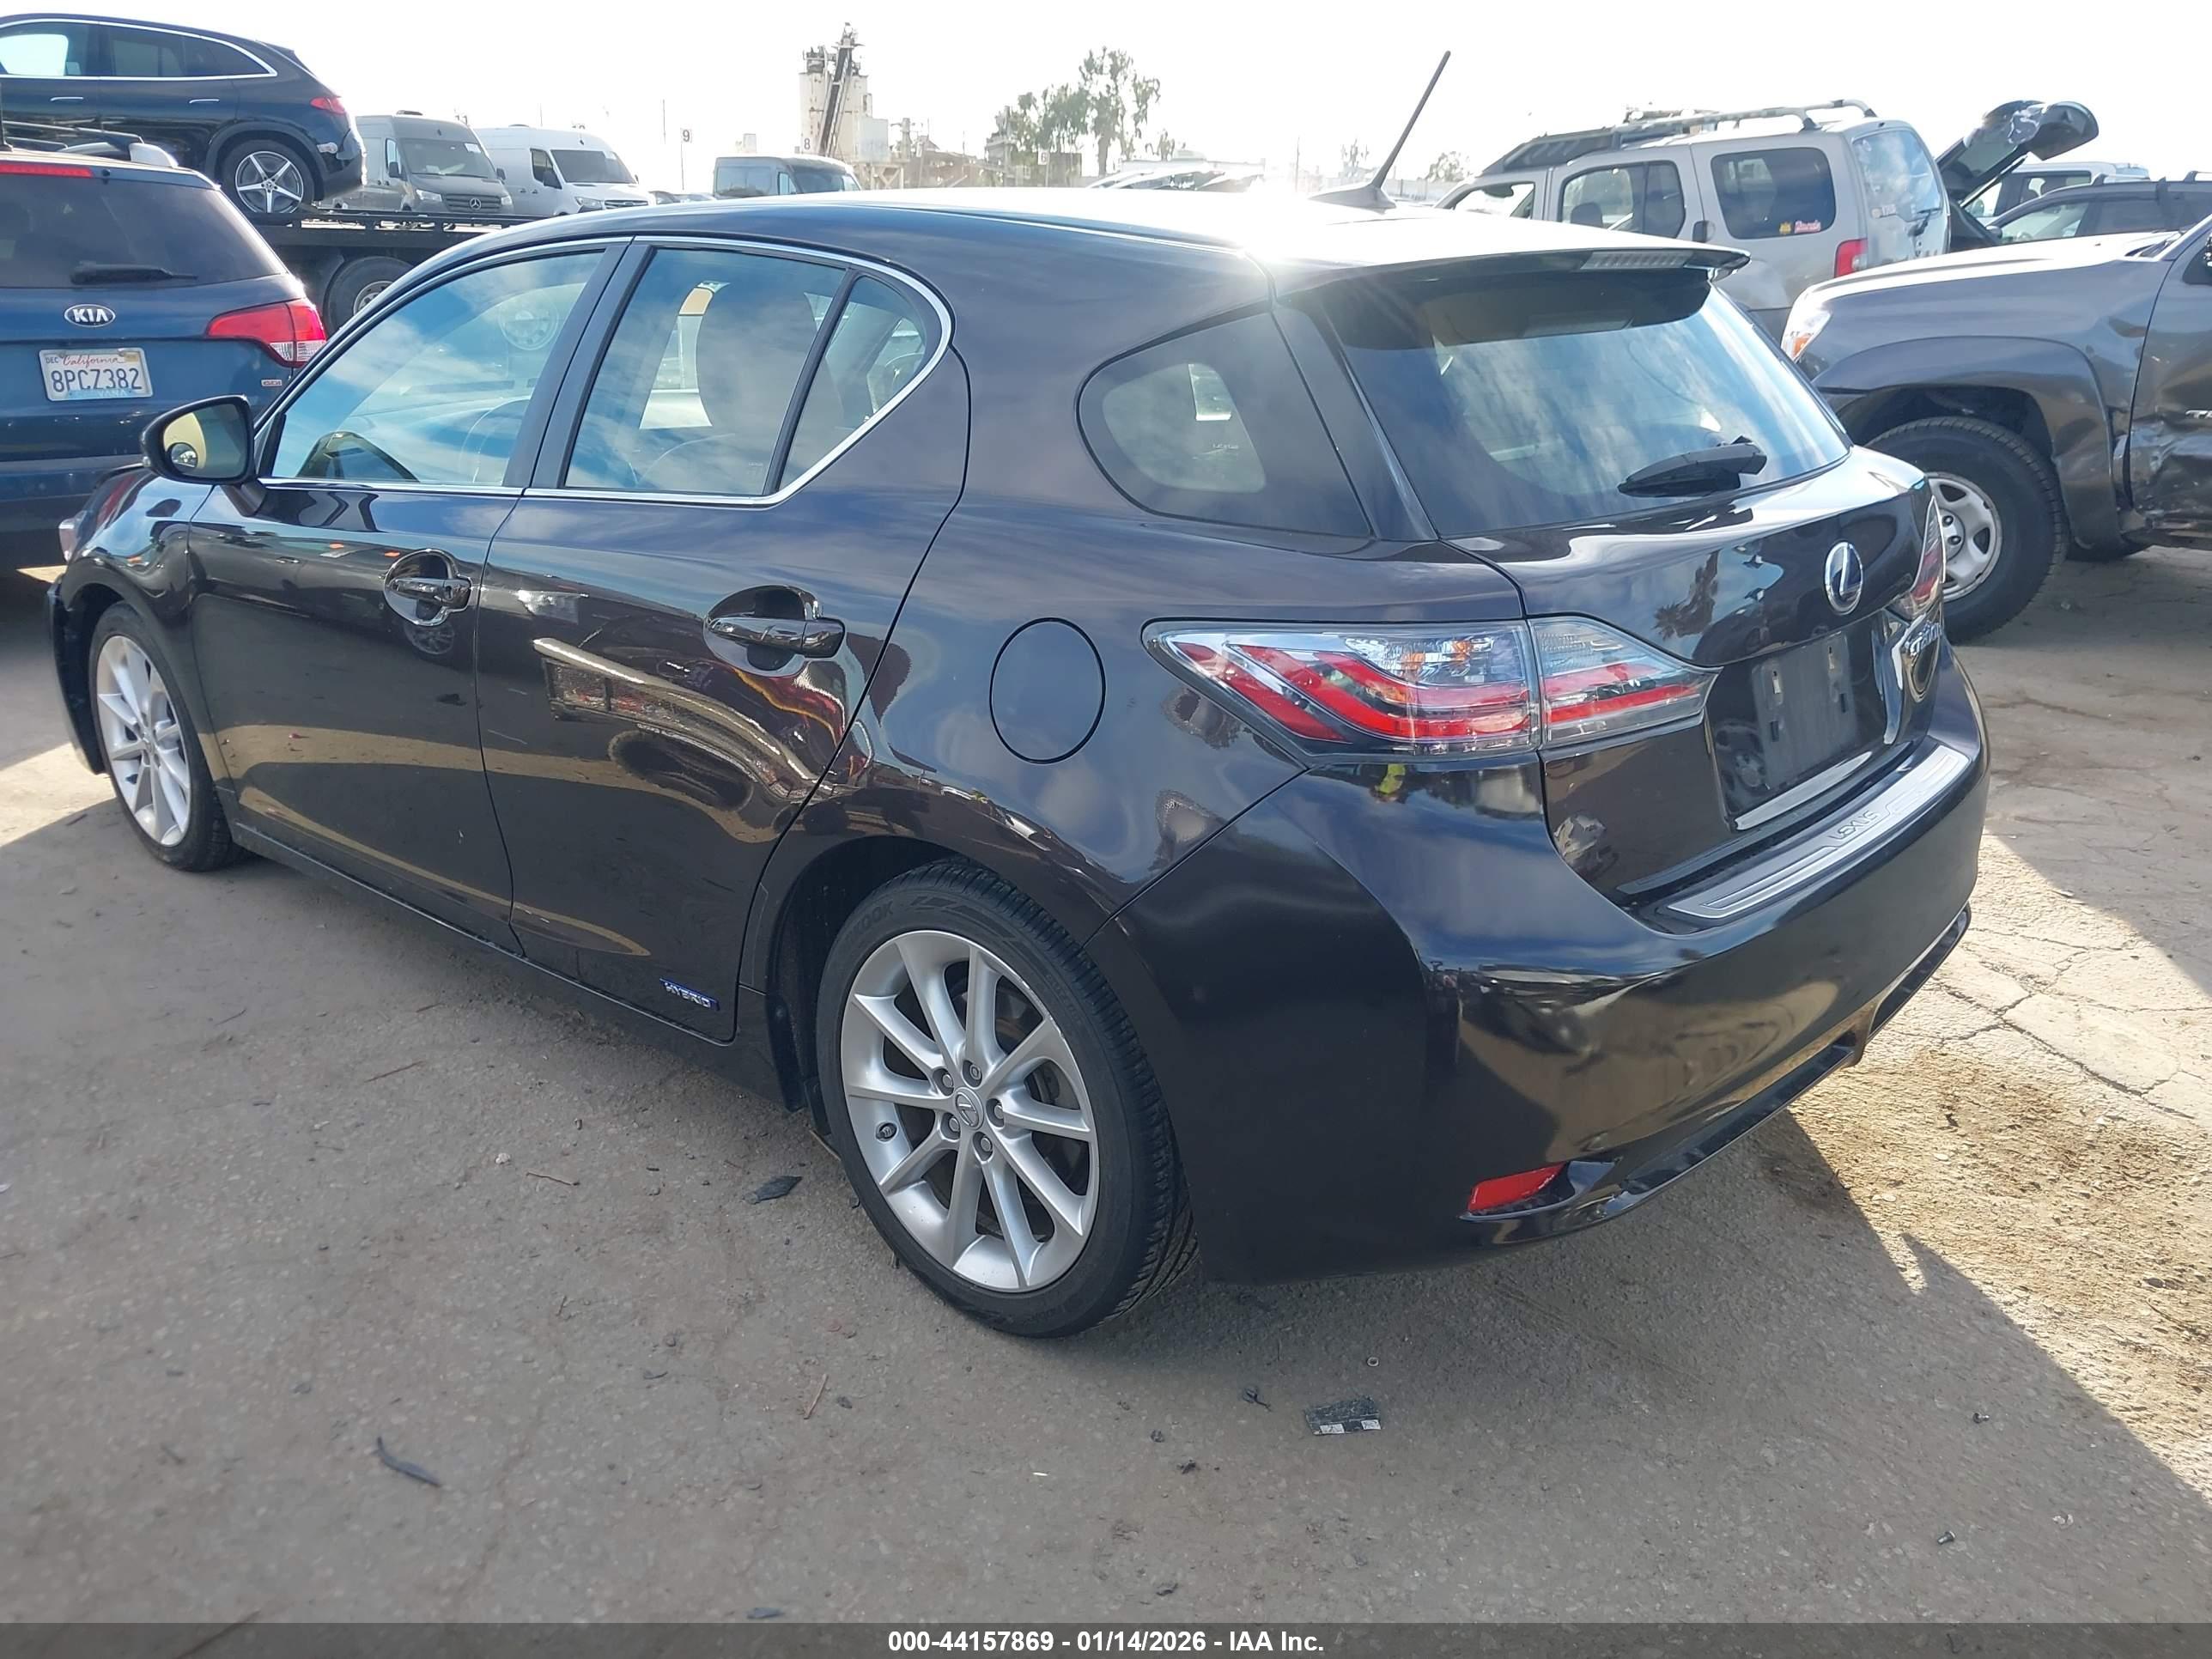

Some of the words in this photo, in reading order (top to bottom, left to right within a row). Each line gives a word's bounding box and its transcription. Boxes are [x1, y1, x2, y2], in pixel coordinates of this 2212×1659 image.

[683, 129, 690, 143] 9
[804, 137, 811, 150] 8
[72, 308, 109, 322] KIA
[61, 355, 123, 368] California
[51, 368, 143, 392] 8PCZ382
[1827, 810, 1881, 840] LEXUS
[665, 981, 711, 1008] HYBRID
